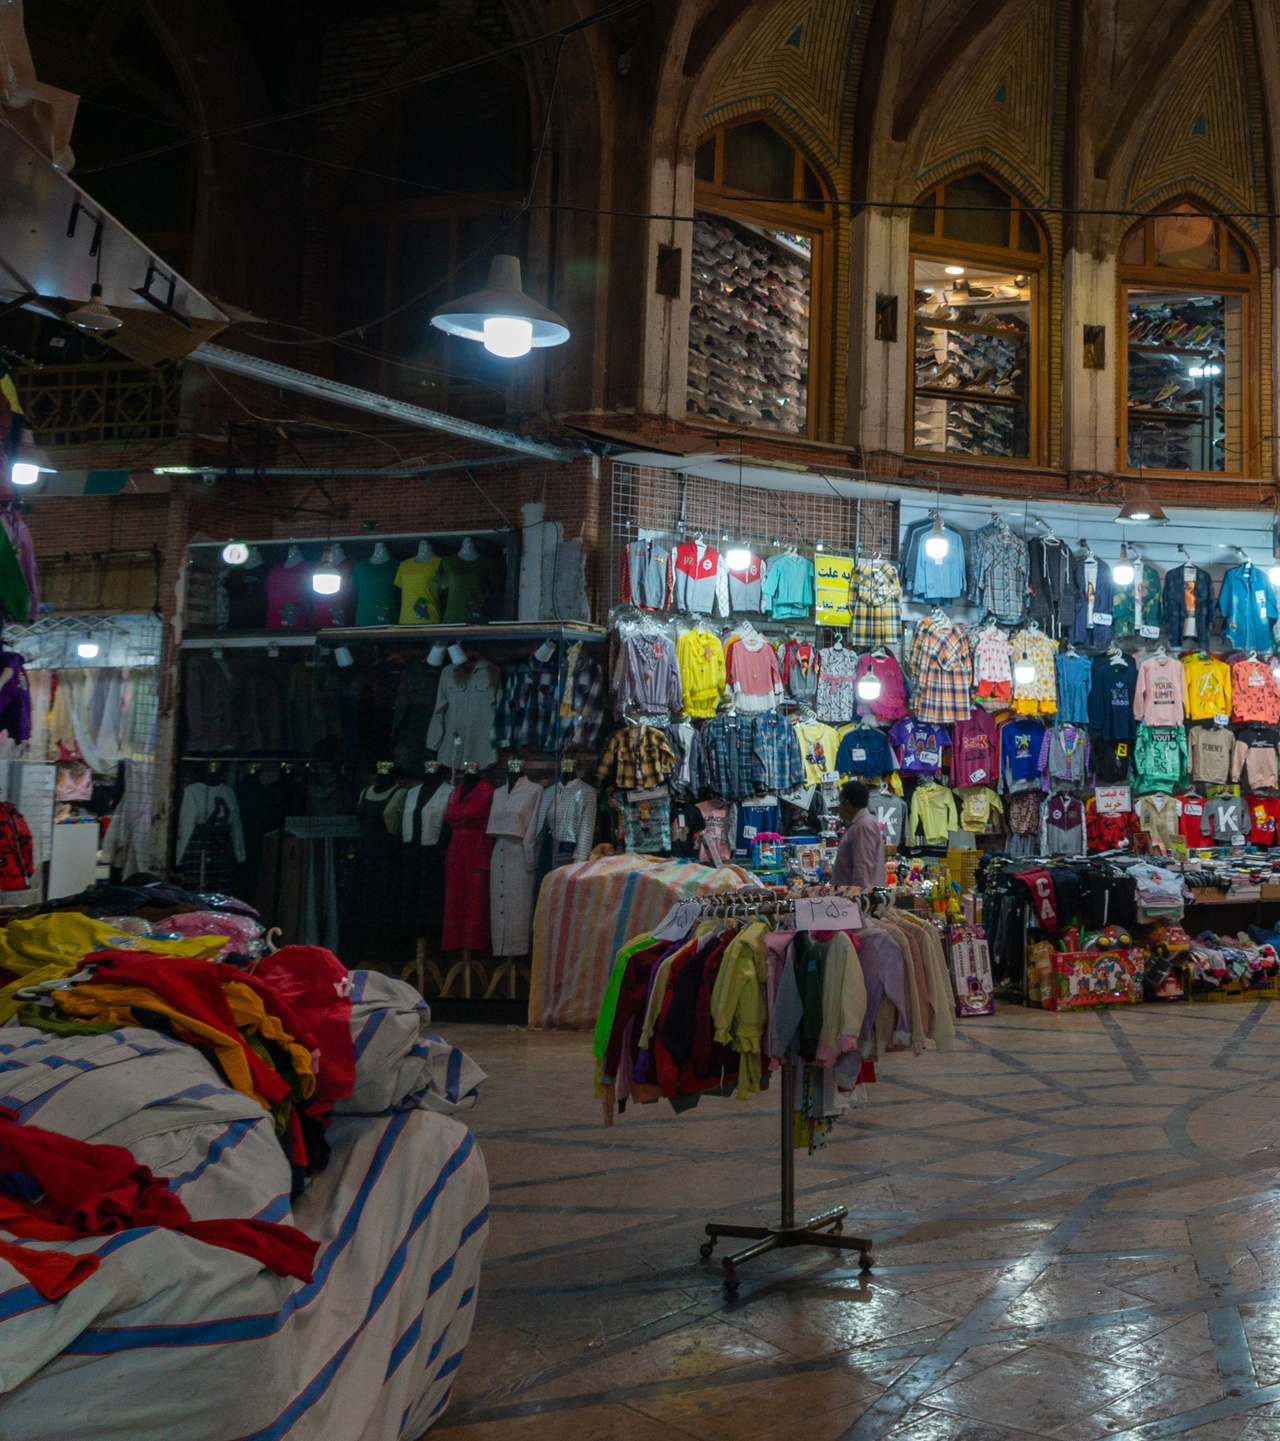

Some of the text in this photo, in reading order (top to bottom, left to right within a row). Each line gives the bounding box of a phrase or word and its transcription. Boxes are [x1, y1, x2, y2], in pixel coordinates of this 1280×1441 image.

[818, 567, 839, 579] علت
[1155, 691, 1173, 699] LIMIT
[1202, 743, 1224, 753] TOMMY
[1099, 789, 1126, 799] به قیمت
[1104, 800, 1122, 810] خرید
